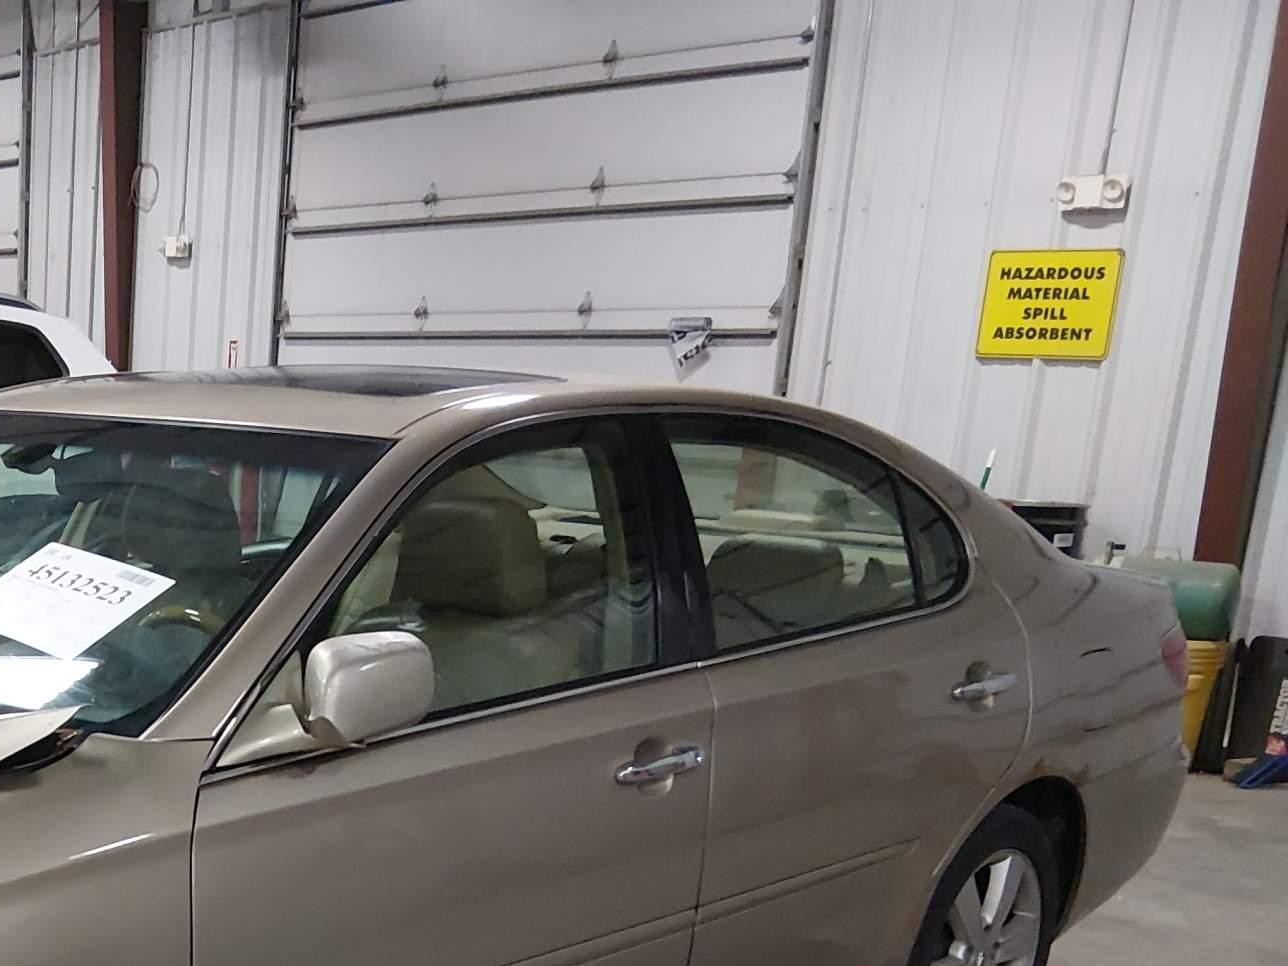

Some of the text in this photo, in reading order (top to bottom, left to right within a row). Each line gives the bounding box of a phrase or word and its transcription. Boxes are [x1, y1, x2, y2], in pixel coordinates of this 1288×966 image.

[1000, 267, 1106, 280] HAZARDOUS
[1007, 287, 1090, 300] MATERIAL
[1022, 307, 1067, 320] SPILL
[993, 327, 1093, 340] ABSORBENT
[28, 564, 133, 606] 45132523
